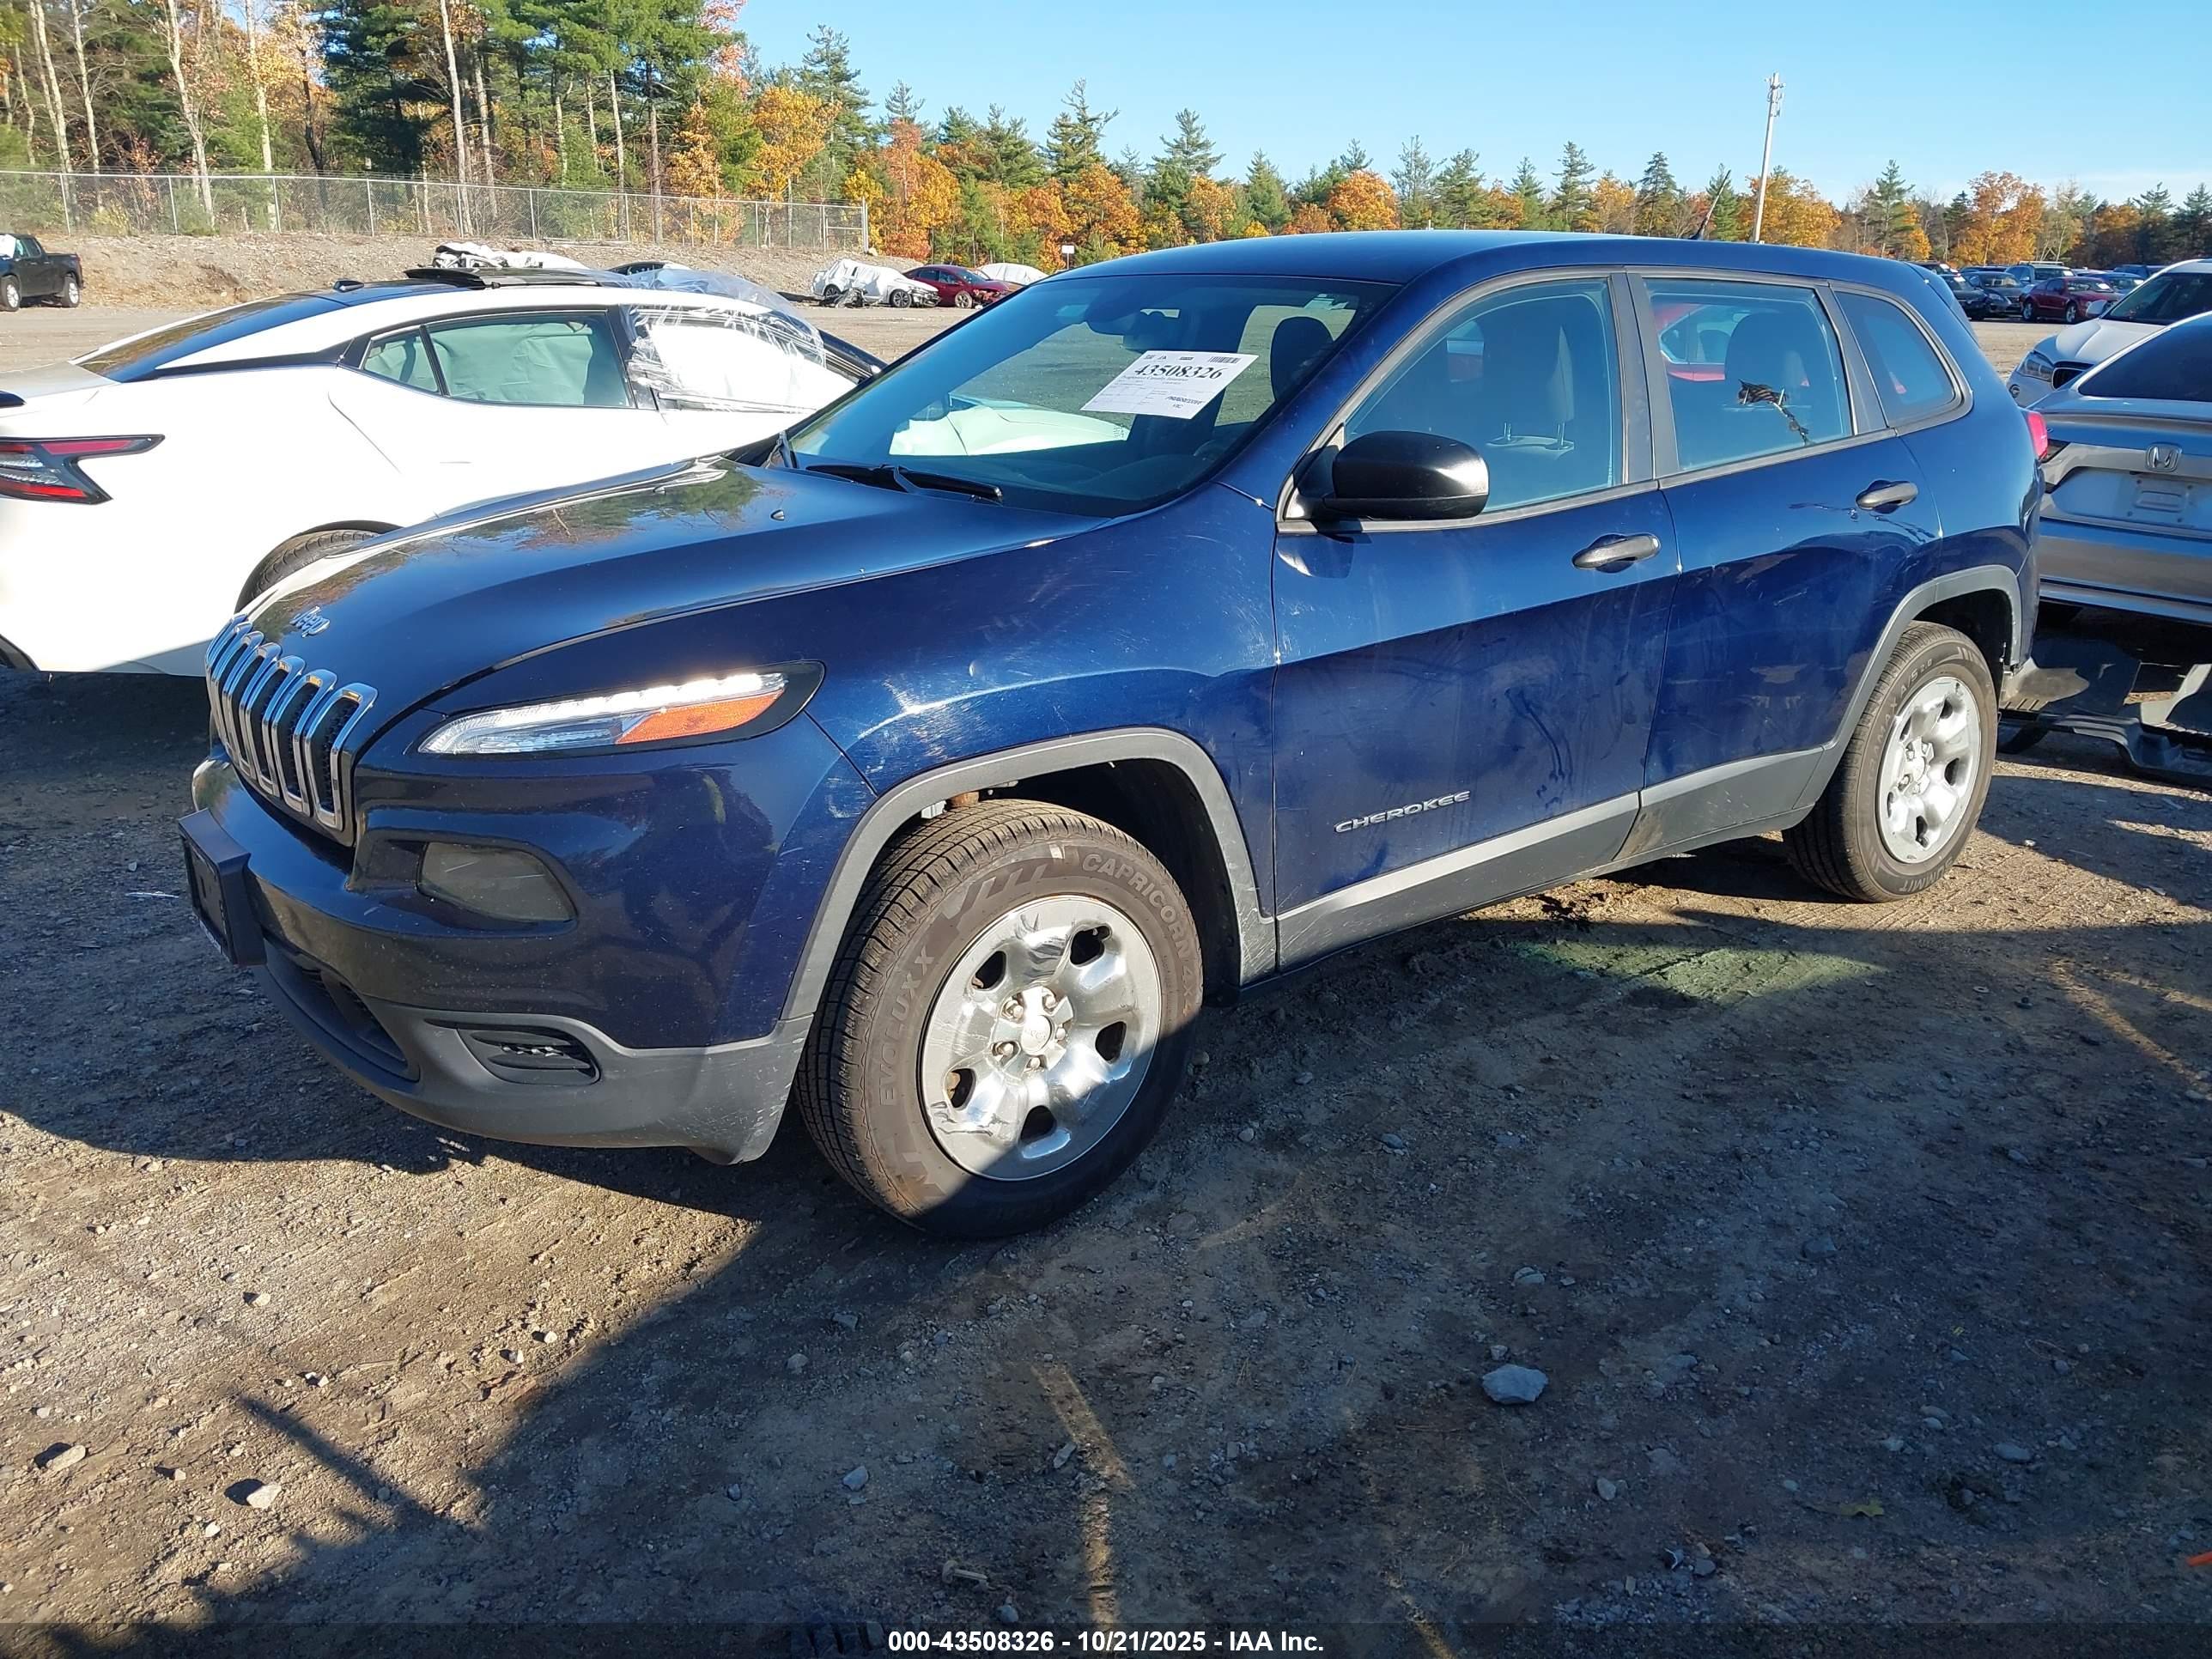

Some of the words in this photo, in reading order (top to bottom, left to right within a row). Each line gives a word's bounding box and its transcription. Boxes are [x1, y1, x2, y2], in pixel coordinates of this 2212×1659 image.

[1134, 363, 1227, 380] 43508326
[289, 606, 331, 638] Jeep
[1334, 790, 1471, 834] CHEROKEE
[1082, 853, 1192, 961] CAPRICORN
[878, 945, 935, 1107] EVOLUXX
